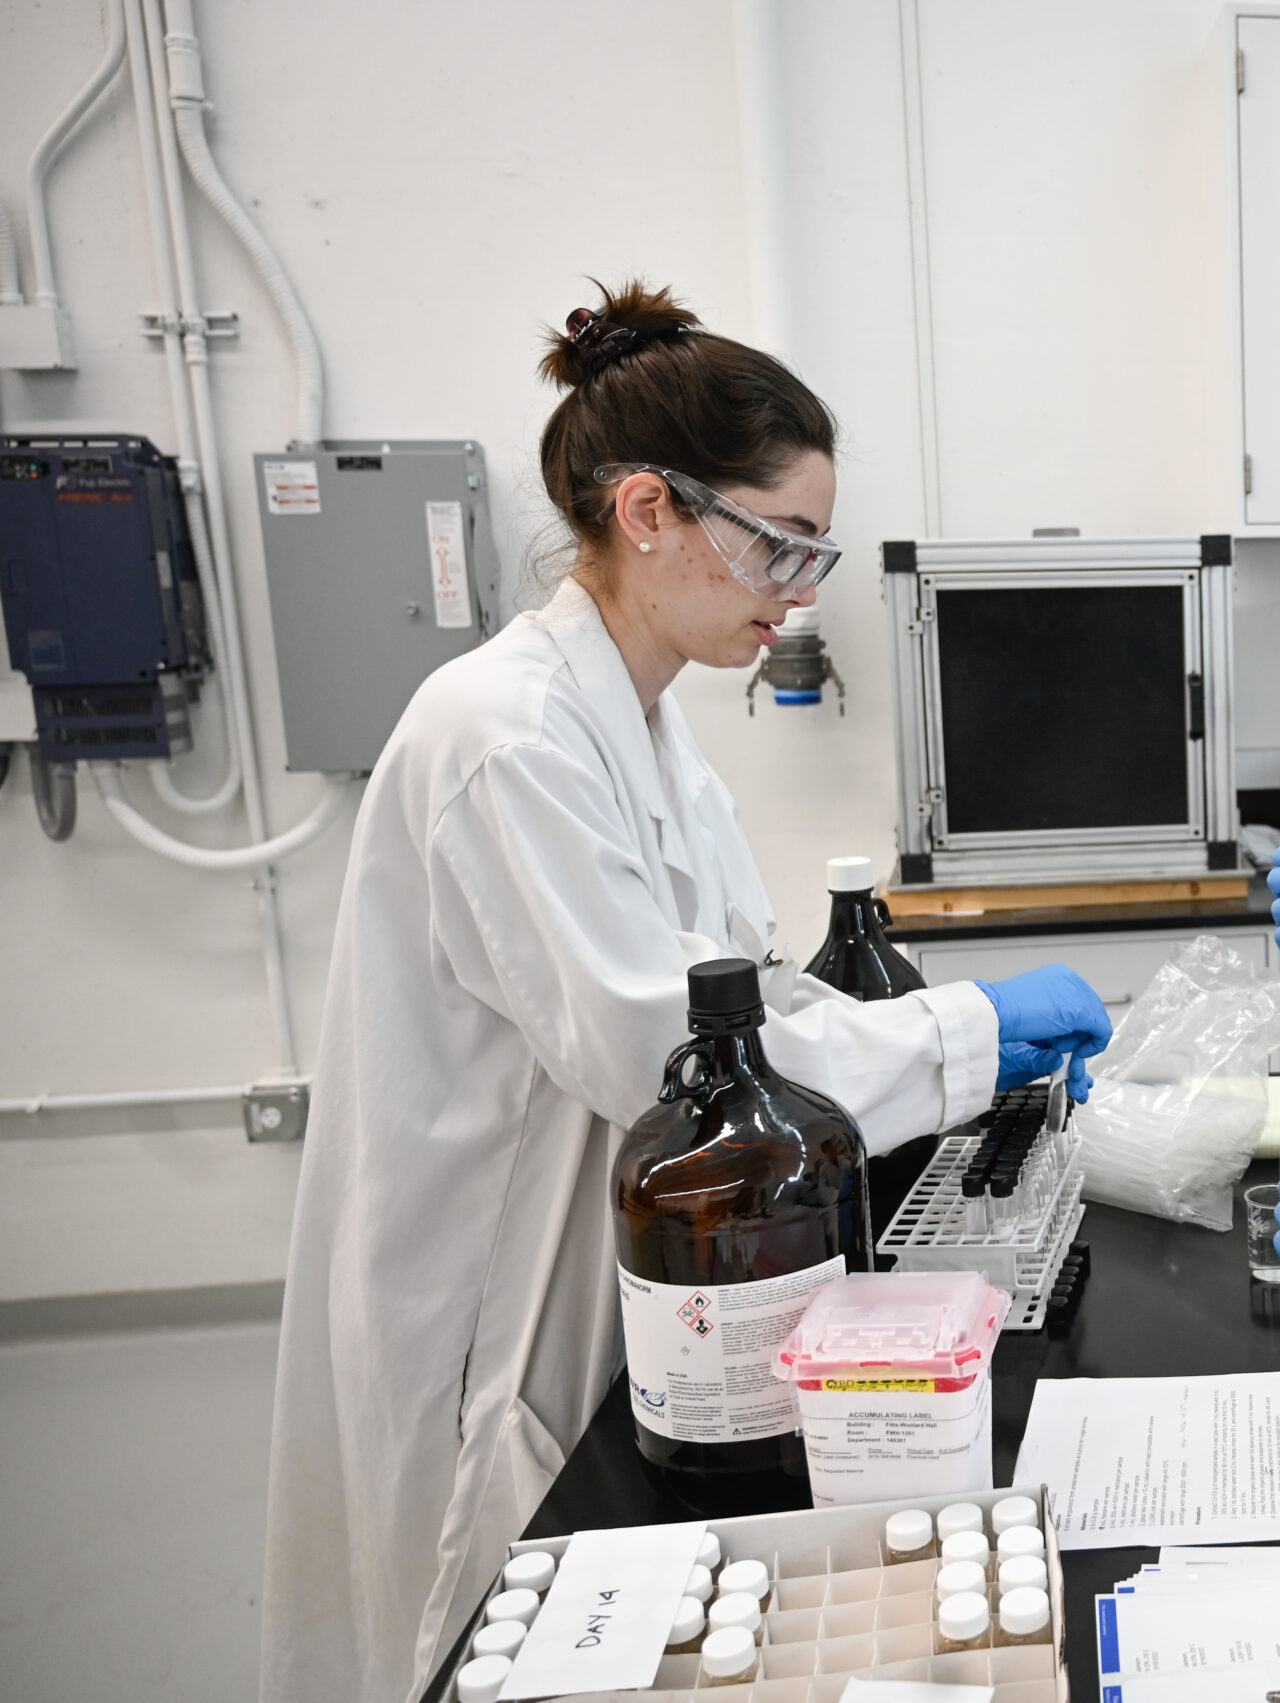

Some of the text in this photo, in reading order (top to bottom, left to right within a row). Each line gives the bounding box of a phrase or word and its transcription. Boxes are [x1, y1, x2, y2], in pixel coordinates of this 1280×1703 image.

[432, 534, 451, 544] ON
[437, 590, 459, 600] OFF
[574, 1614, 613, 1649] DAY
